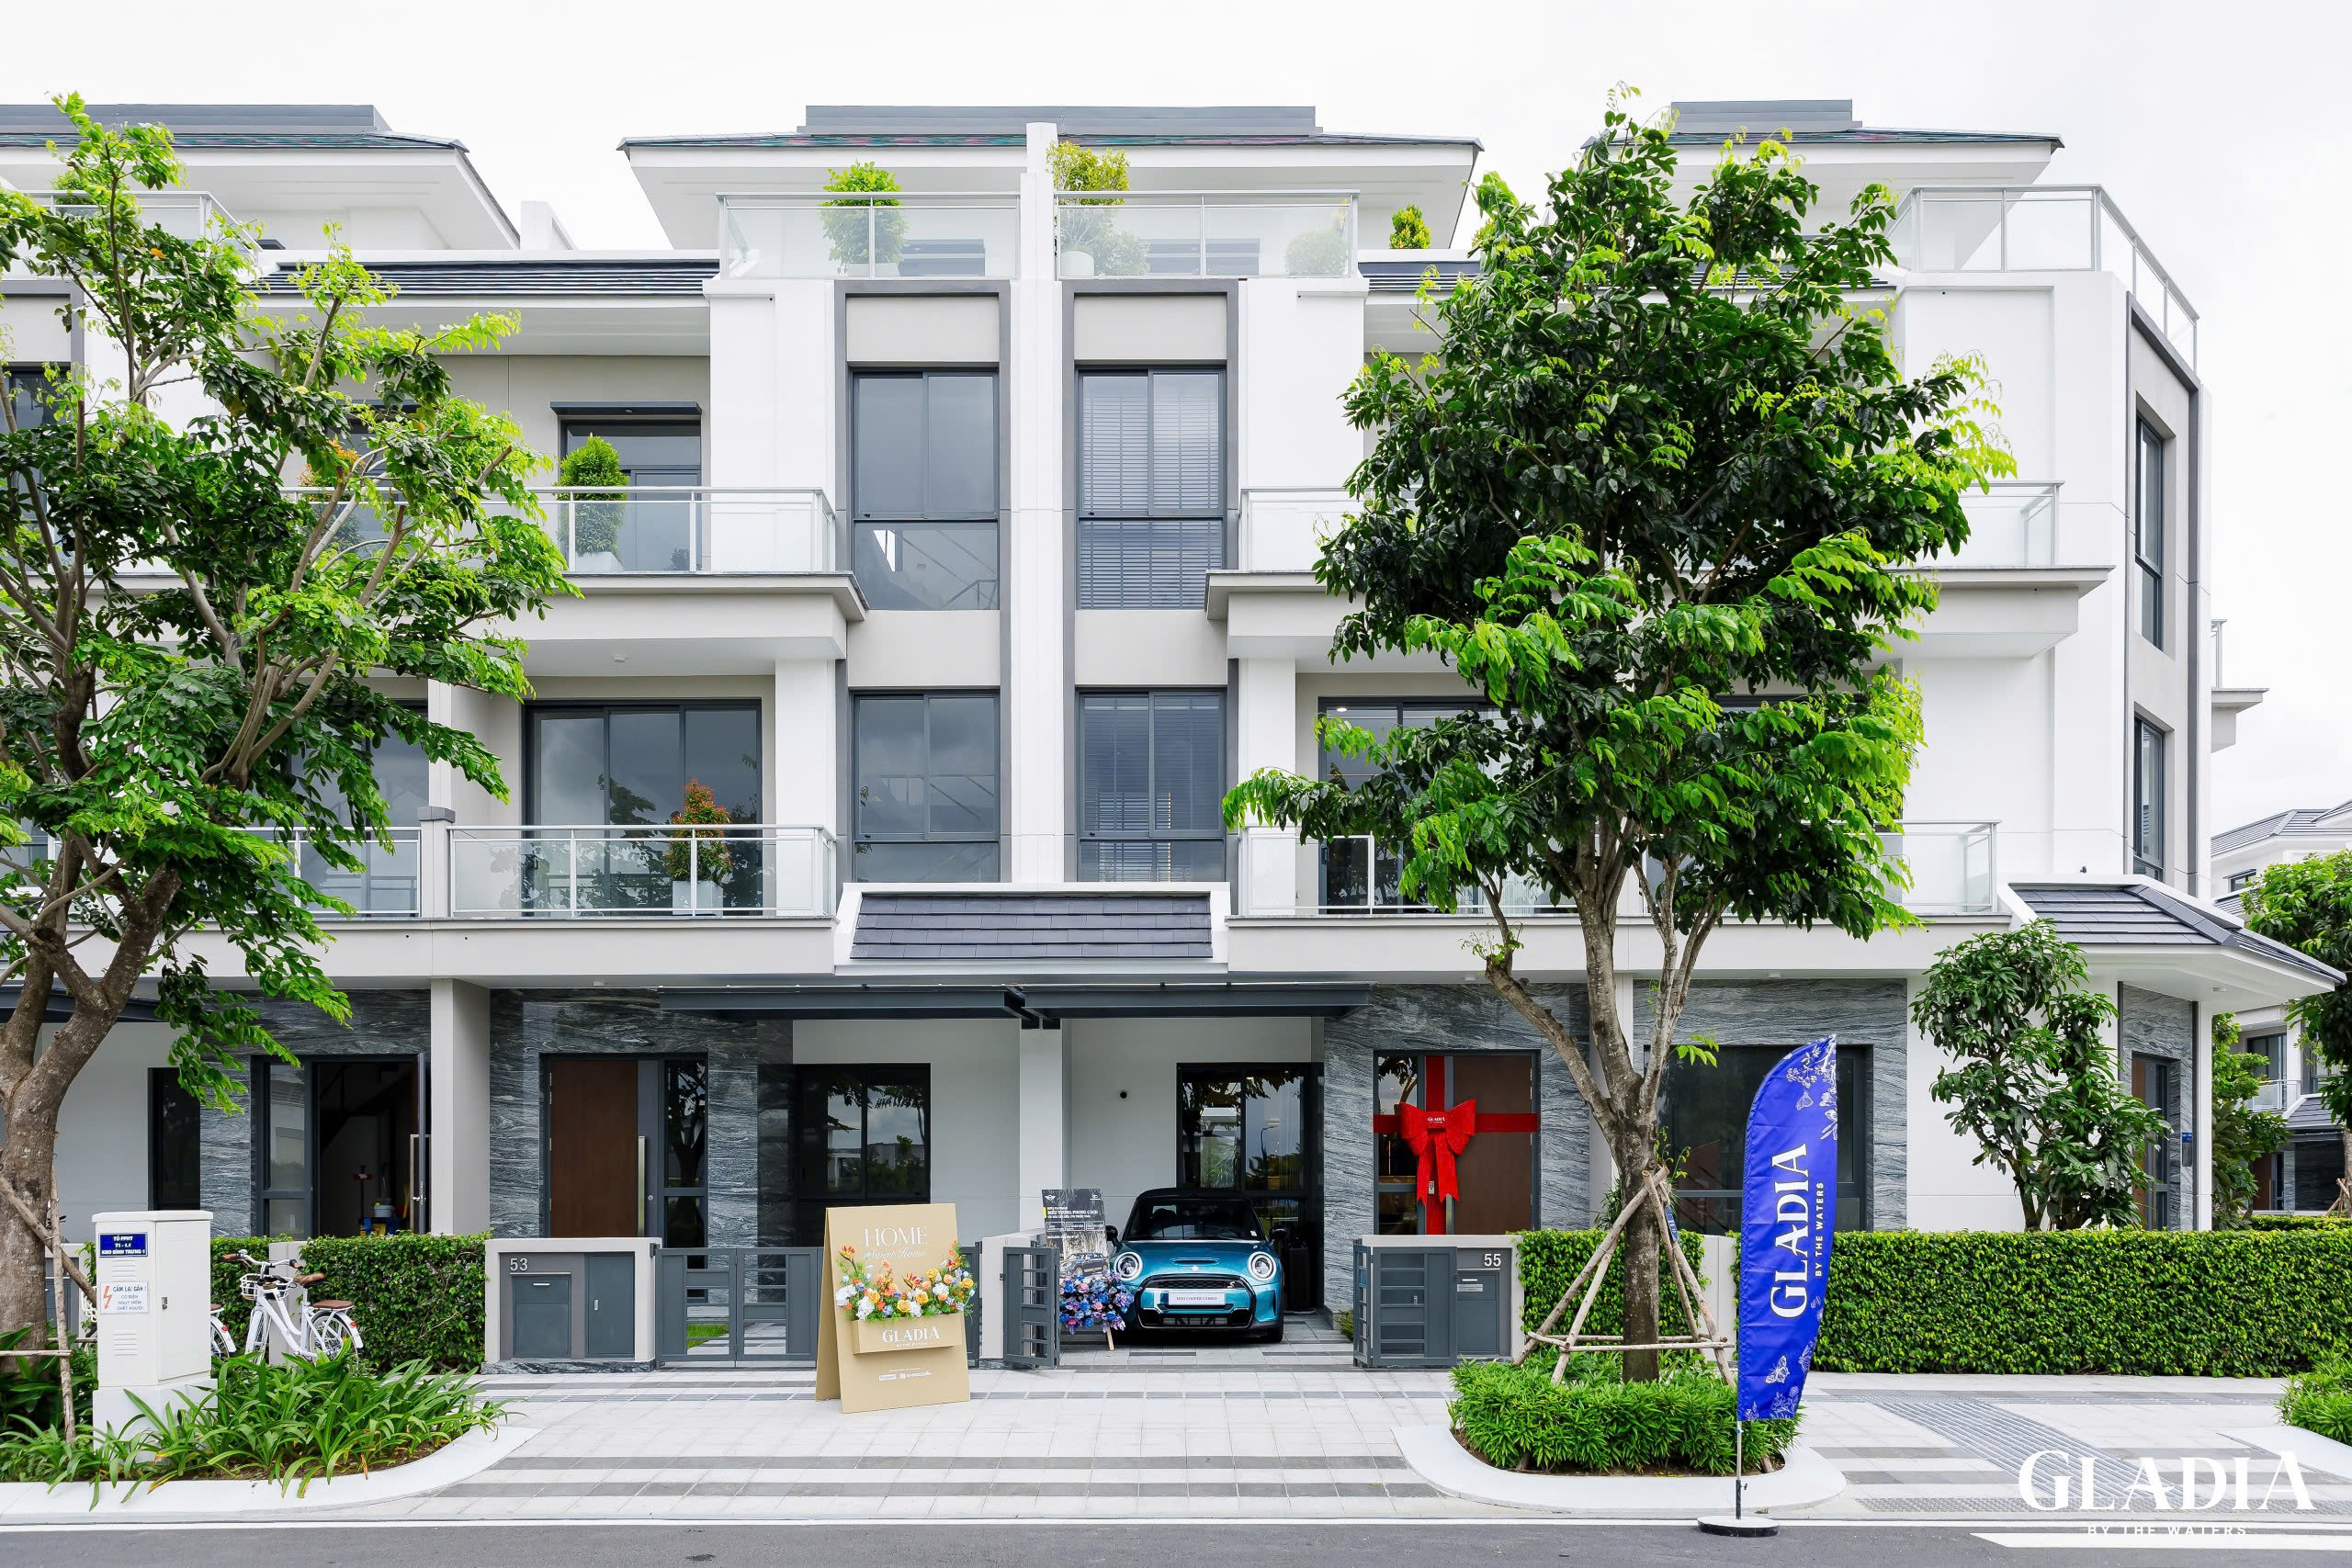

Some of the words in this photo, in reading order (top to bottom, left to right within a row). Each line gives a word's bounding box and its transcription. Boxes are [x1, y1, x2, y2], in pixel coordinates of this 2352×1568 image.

[1815, 1182, 1824, 1230] WATERS
[865, 1226, 928, 1247] HOME
[1770, 1143, 1809, 1318] GLADIA
[870, 1248, 894, 1259] Sweet
[898, 1247, 927, 1258] Home
[1815, 1235, 1824, 1257] THE
[510, 1258, 528, 1271] 53
[1484, 1253, 1501, 1267] 55
[1815, 1262, 1823, 1277] BY
[882, 1325, 941, 1343] GLADIA
